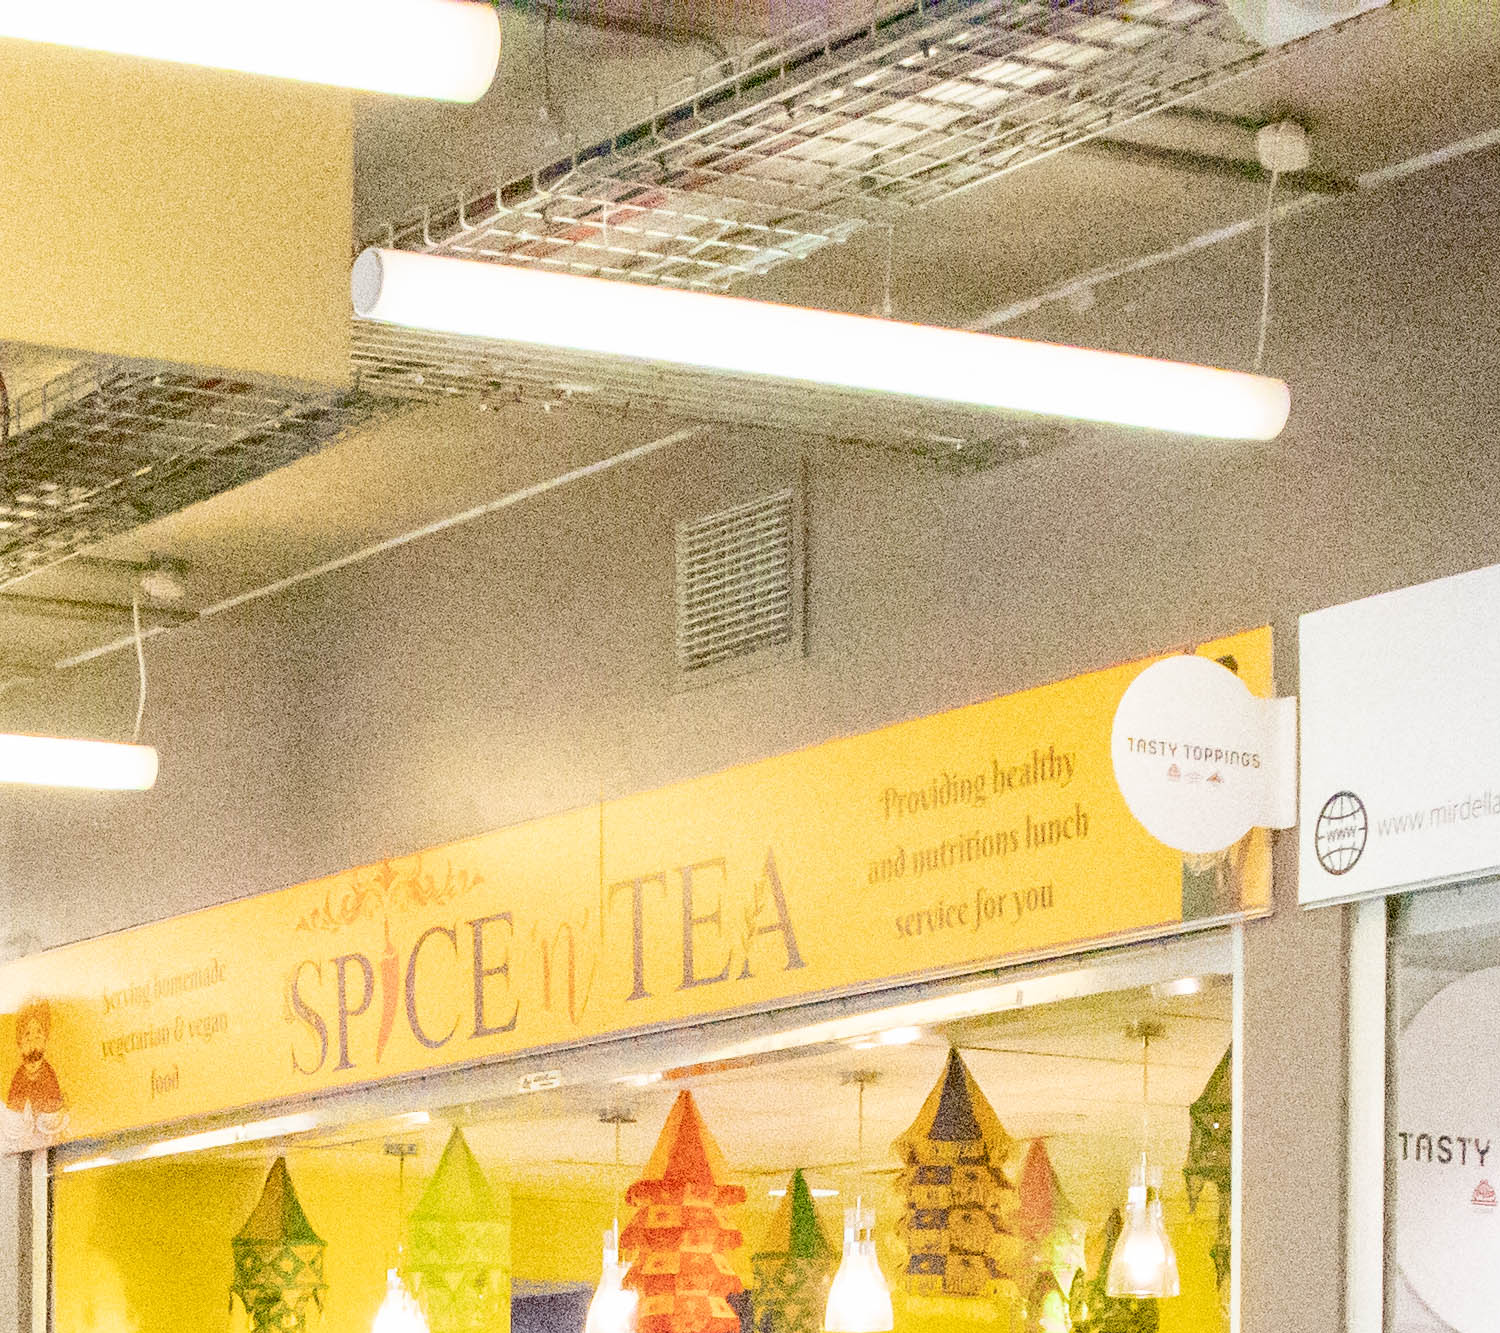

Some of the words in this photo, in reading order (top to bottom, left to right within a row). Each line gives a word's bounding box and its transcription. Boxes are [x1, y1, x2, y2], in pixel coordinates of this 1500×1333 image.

[880, 769, 987, 821] Providing
[991, 744, 1077, 795] healthy
[1126, 736, 1179, 758] TASTY
[1183, 743, 1262, 770] TOPPINGS
[868, 845, 906, 884] and
[1024, 801, 1091, 850] lunch
[893, 899, 969, 940] service
[971, 886, 1007, 935] for
[1011, 883, 1056, 927] you
[288, 911, 522, 1077] SPICE
[604, 846, 804, 1002] TEA
[1397, 1131, 1492, 1169] TASTY
